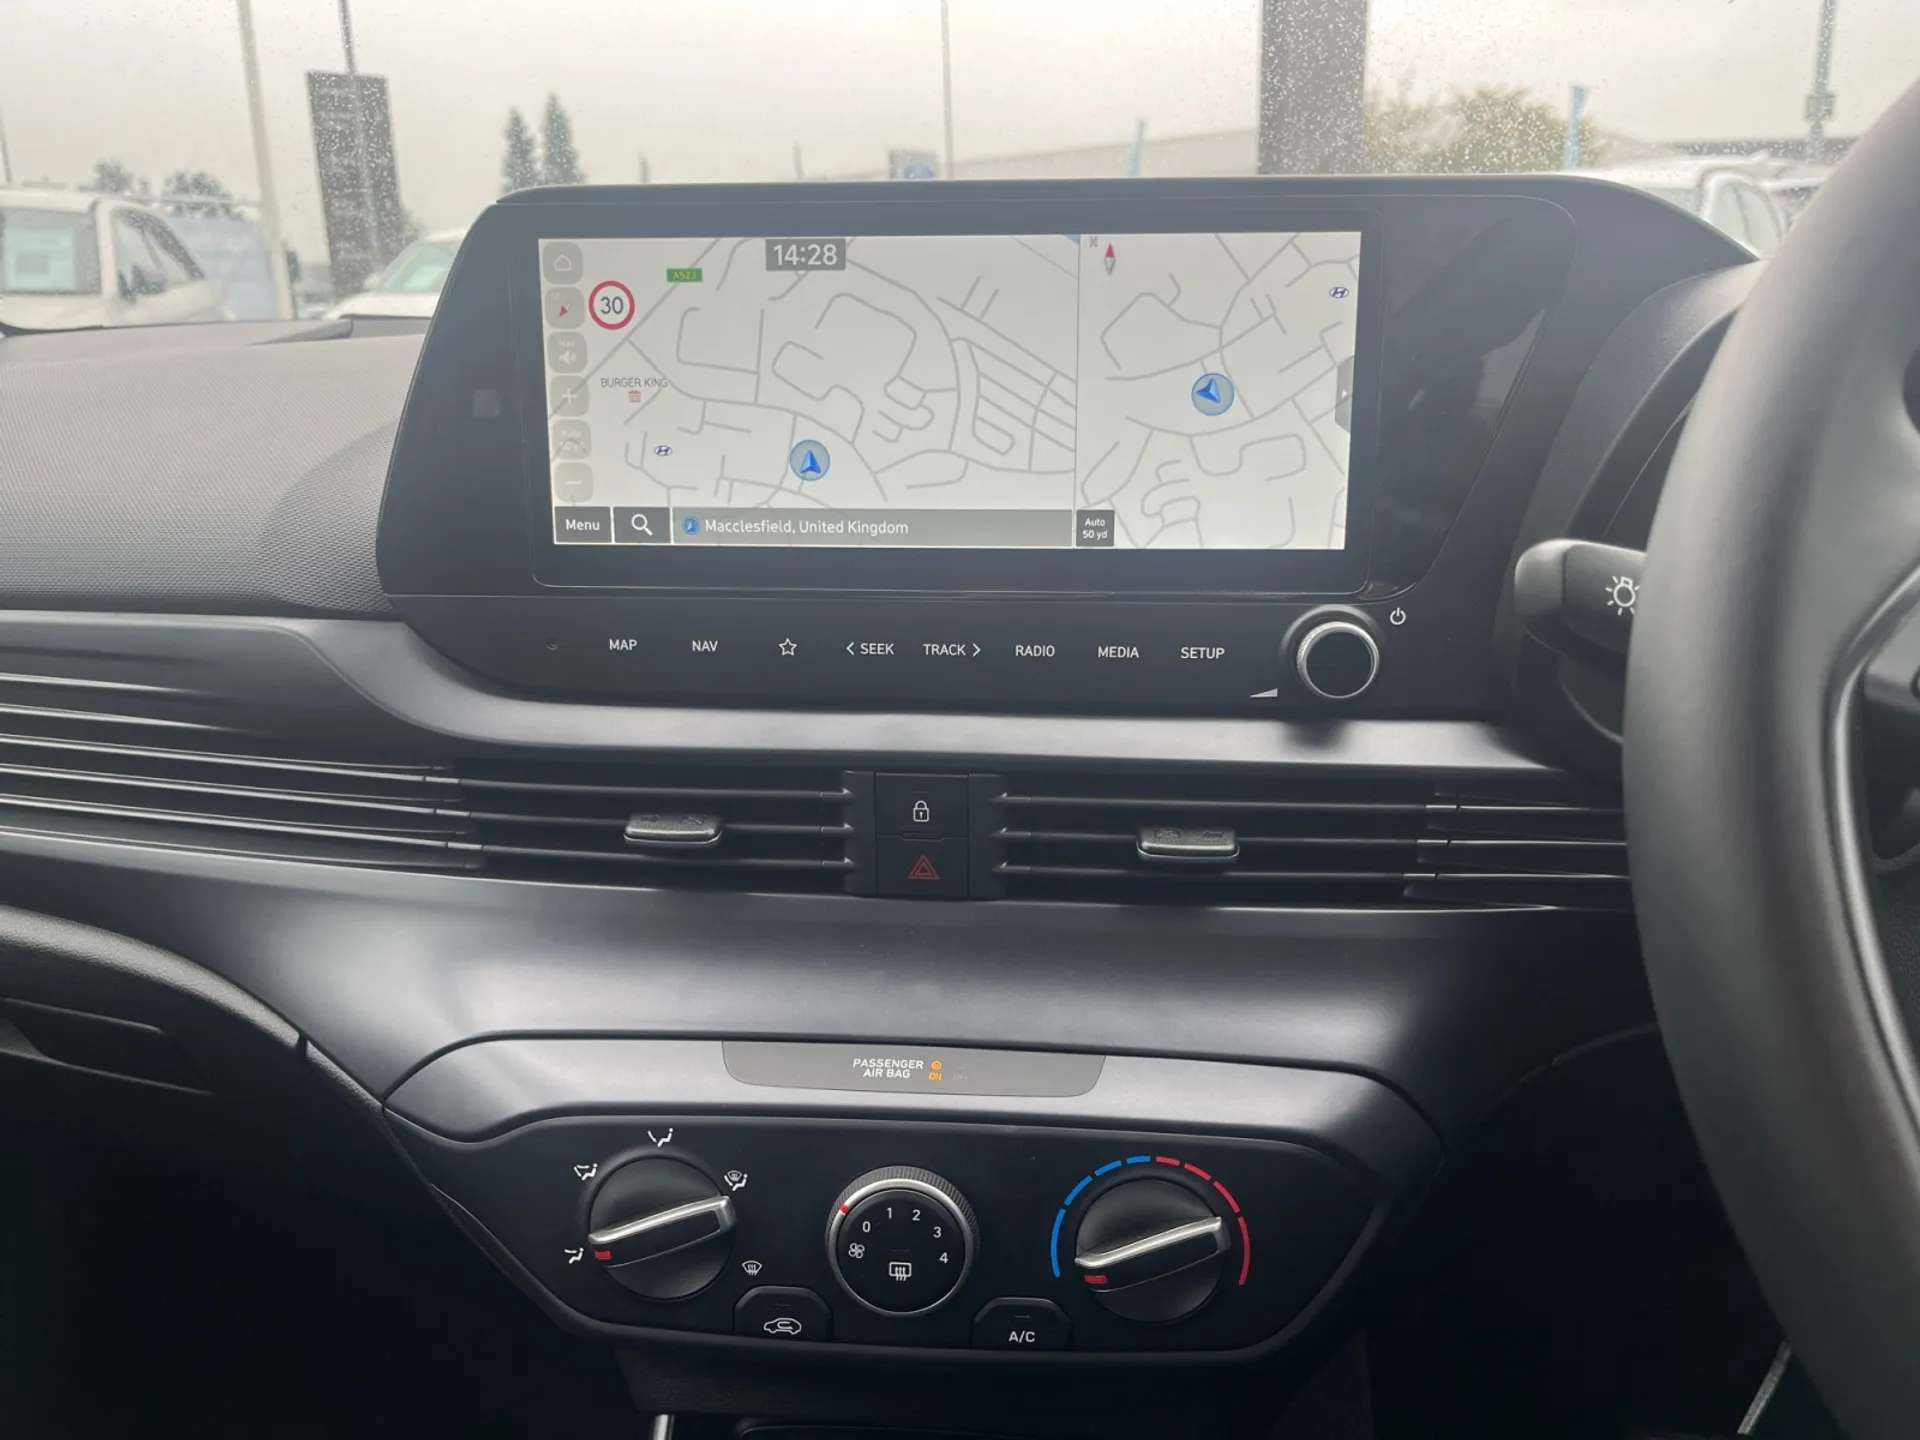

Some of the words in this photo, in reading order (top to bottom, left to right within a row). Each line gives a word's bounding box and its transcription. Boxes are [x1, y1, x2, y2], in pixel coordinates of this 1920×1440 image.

[773, 244, 837, 266] 14:28
[600, 296, 624, 315] 30
[601, 377, 641, 388] BURGER
[644, 378, 668, 389] KING
[566, 519, 600, 531] Menu
[705, 519, 796, 535] Macclesfield,
[799, 520, 844, 534] United
[848, 520, 909, 536] Kingdom
[1085, 517, 1106, 527] Auto
[1082, 529, 1095, 539] 50
[1097, 529, 1108, 541] yd
[609, 638, 638, 651] MAP
[692, 640, 718, 652] NAV
[860, 642, 895, 655] SEEK
[923, 643, 966, 656] TRACK
[1015, 645, 1056, 657] RADIO
[1098, 646, 1140, 658] MEDIA
[1180, 646, 1225, 659] SETUP
[852, 1058, 924, 1069] PASSENGER
[863, 1069, 883, 1078] AIR
[886, 1069, 911, 1079] BAG
[886, 1207, 893, 1219] 1
[911, 1209, 921, 1221] 2
[862, 1221, 872, 1233] 0
[932, 1226, 942, 1238] 3
[939, 1252, 949, 1264] 4
[1008, 1331, 1035, 1343] A/C
